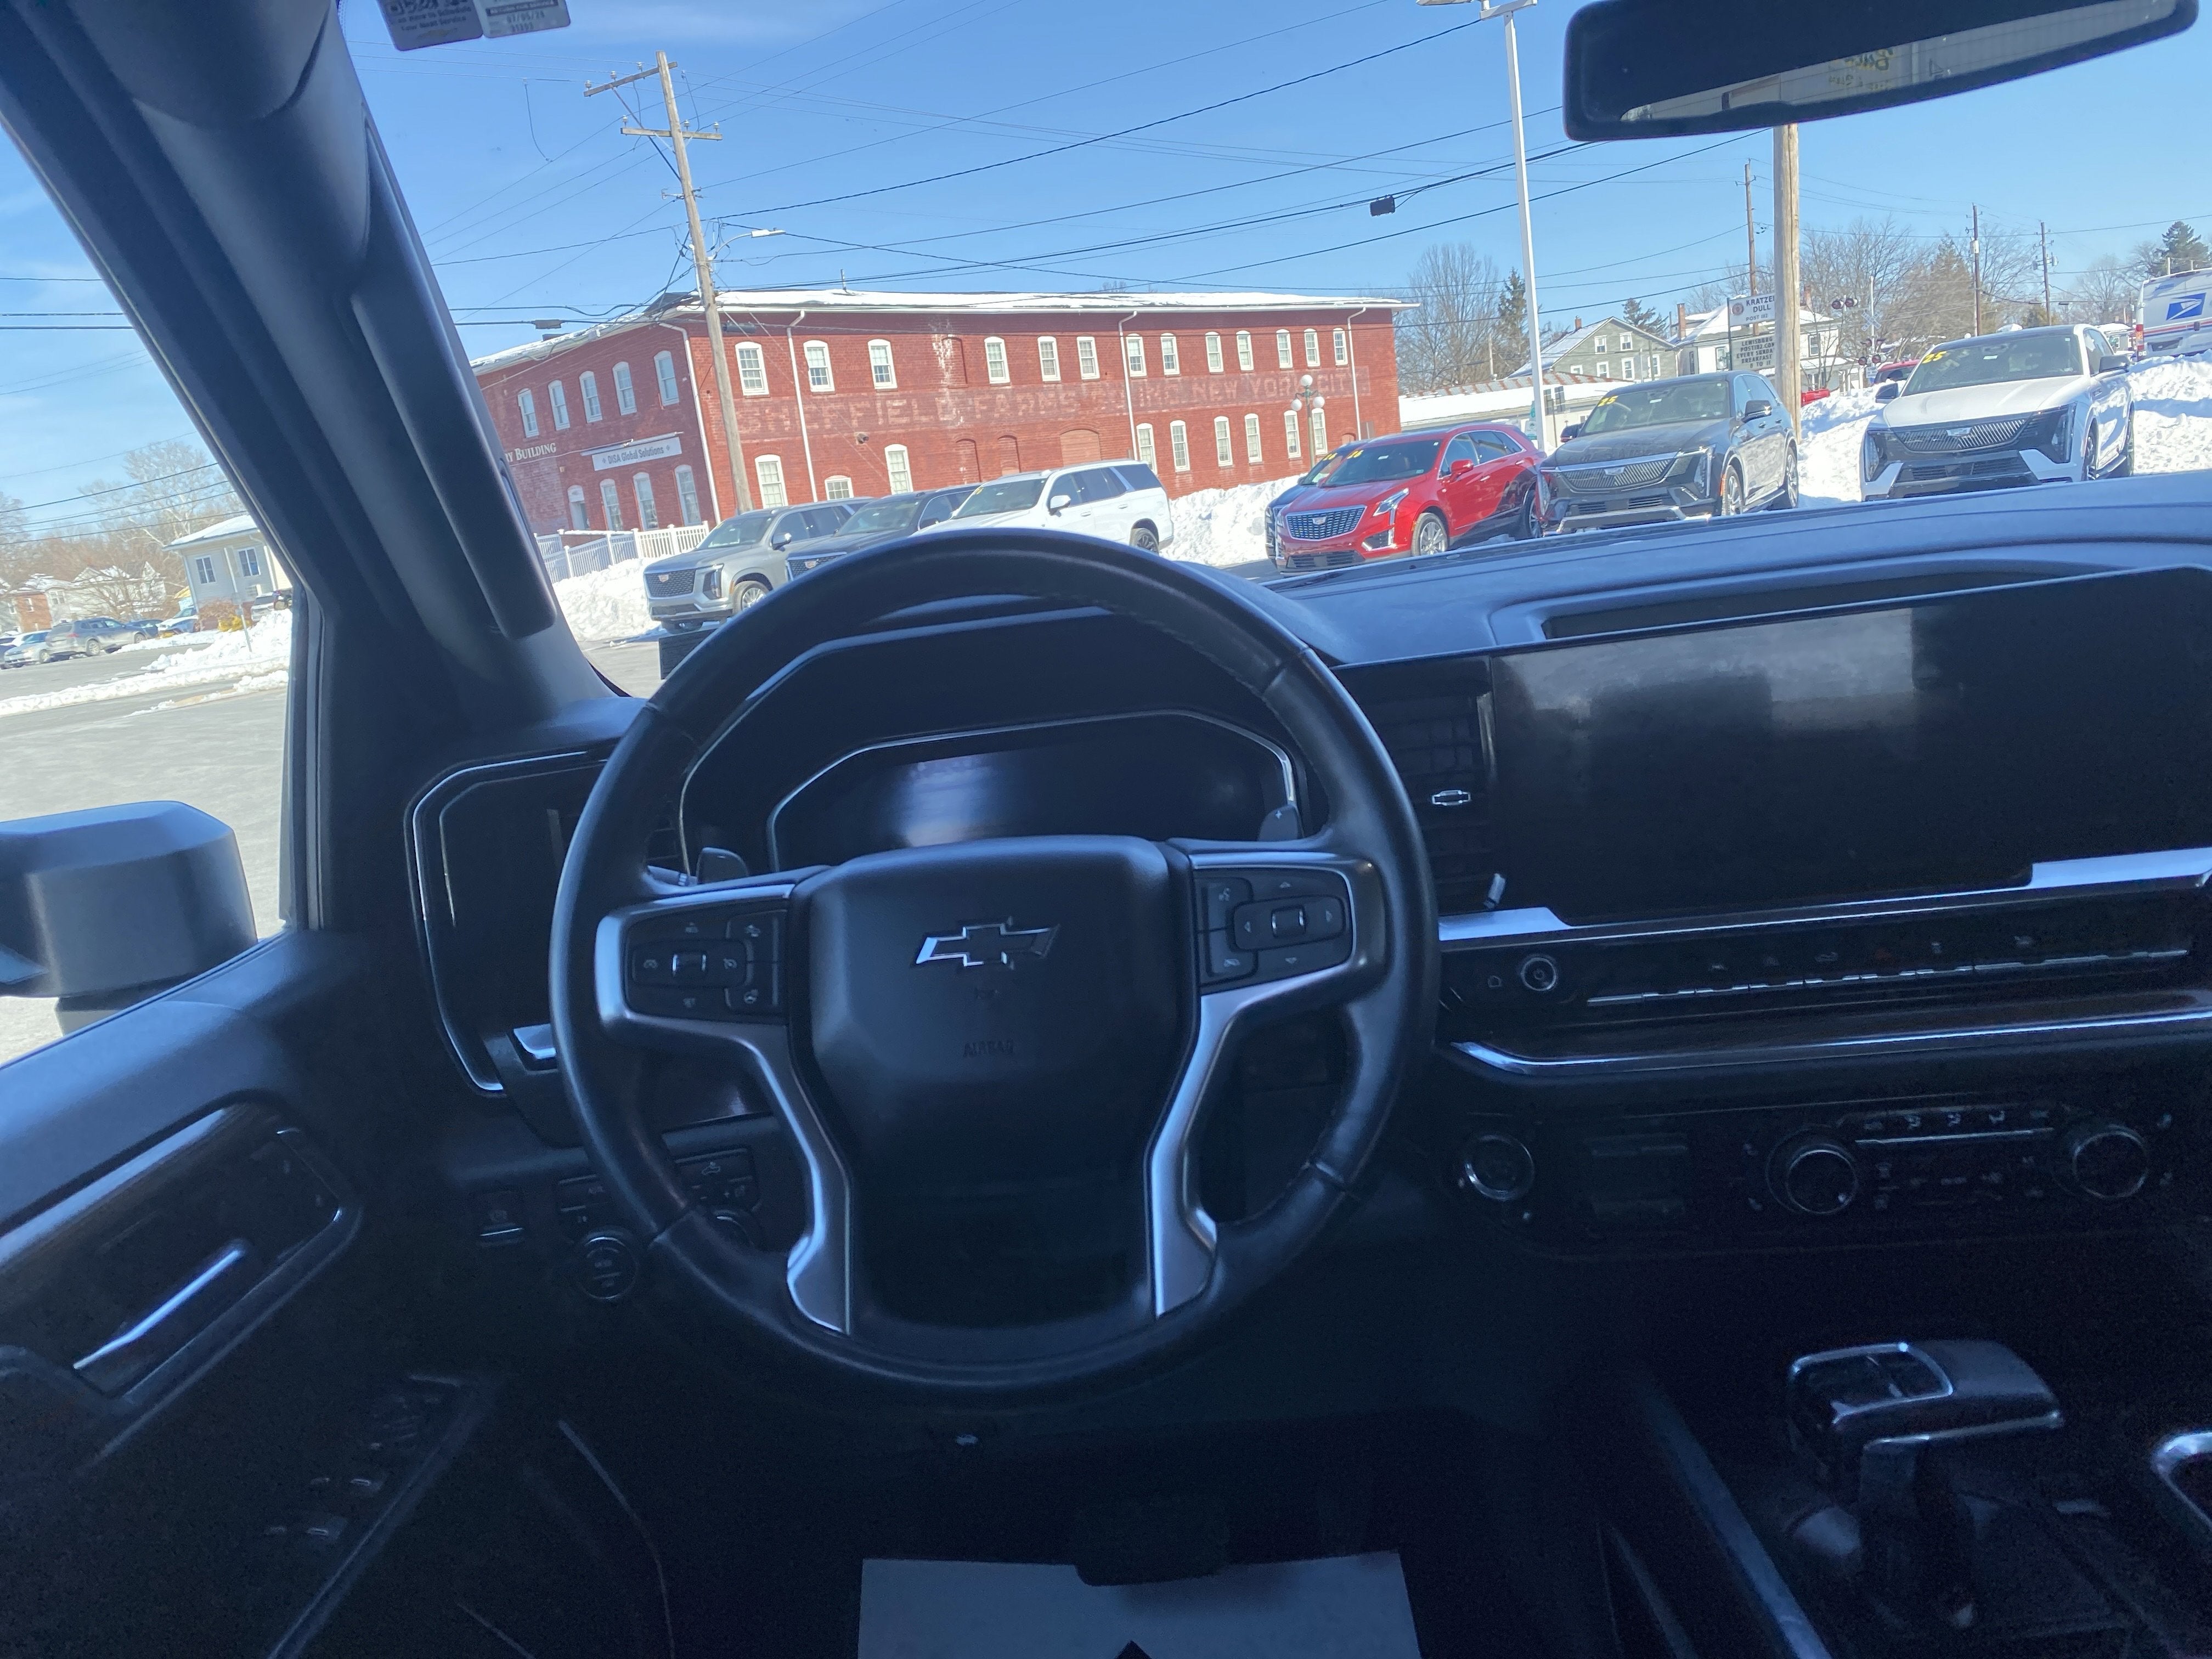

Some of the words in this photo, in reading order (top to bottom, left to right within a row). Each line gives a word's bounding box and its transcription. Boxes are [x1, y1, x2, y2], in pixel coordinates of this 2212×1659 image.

[1746, 296, 1775, 306] KRATZE
[1753, 304, 1771, 313] DULL
[1741, 336, 1773, 346] LEWISBURG
[1736, 351, 1754, 359] EVERY
[1756, 347, 1775, 356] SUNDA
[1922, 351, 1947, 364] 25
[1741, 354, 1773, 364] BREAKFAST
[1192, 380, 1238, 402] NEW
[1597, 396, 1618, 407] 25
[608, 454, 621, 464] DISA
[621, 449, 639, 461] Global
[638, 445, 664, 458] Solutions
